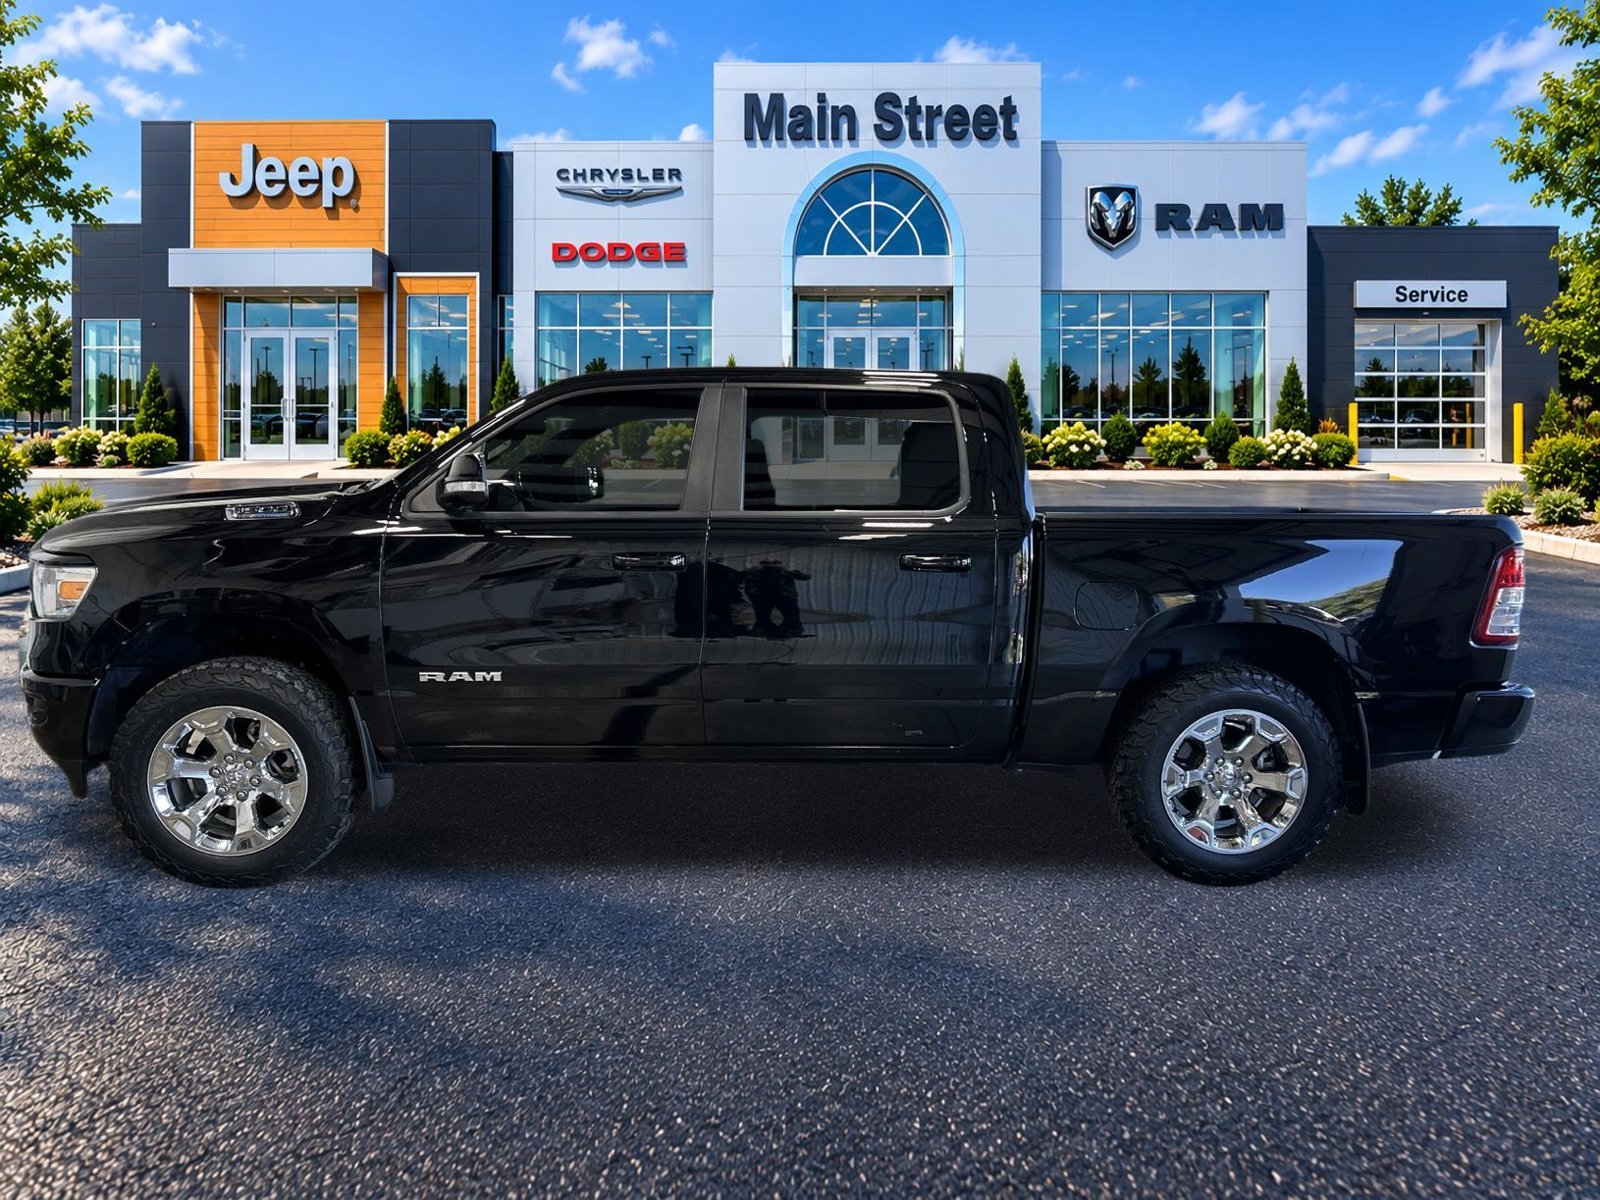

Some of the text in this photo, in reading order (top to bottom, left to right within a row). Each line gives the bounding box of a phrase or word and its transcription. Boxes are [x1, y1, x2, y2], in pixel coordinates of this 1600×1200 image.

[744, 92, 1018, 141] Main Street
[219, 143, 356, 209] Jeep
[556, 167, 682, 183] CHRYSLER
[1155, 203, 1284, 232] RAM
[552, 242, 687, 262] DODGE
[1395, 285, 1468, 303] Service
[418, 671, 503, 682] RAM
